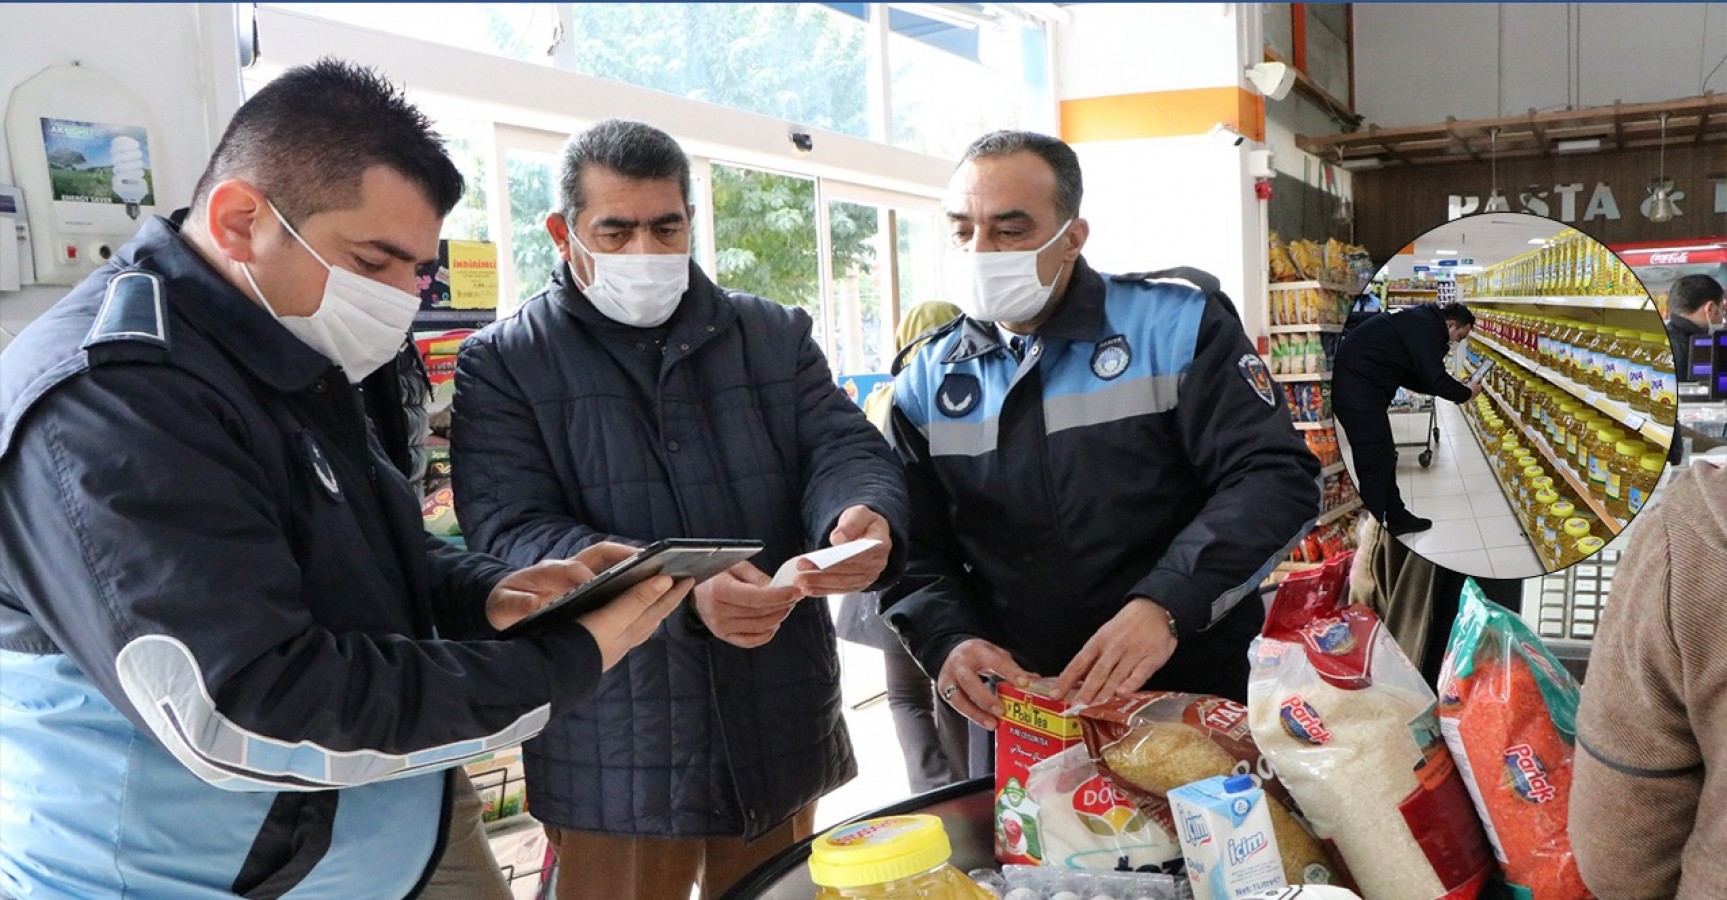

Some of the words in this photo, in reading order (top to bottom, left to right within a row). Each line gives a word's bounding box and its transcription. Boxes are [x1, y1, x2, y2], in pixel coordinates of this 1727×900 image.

[1032, 710, 1048, 729] Tea
[1280, 696, 1333, 744] Parlak
[1504, 743, 1557, 803] Parlak
